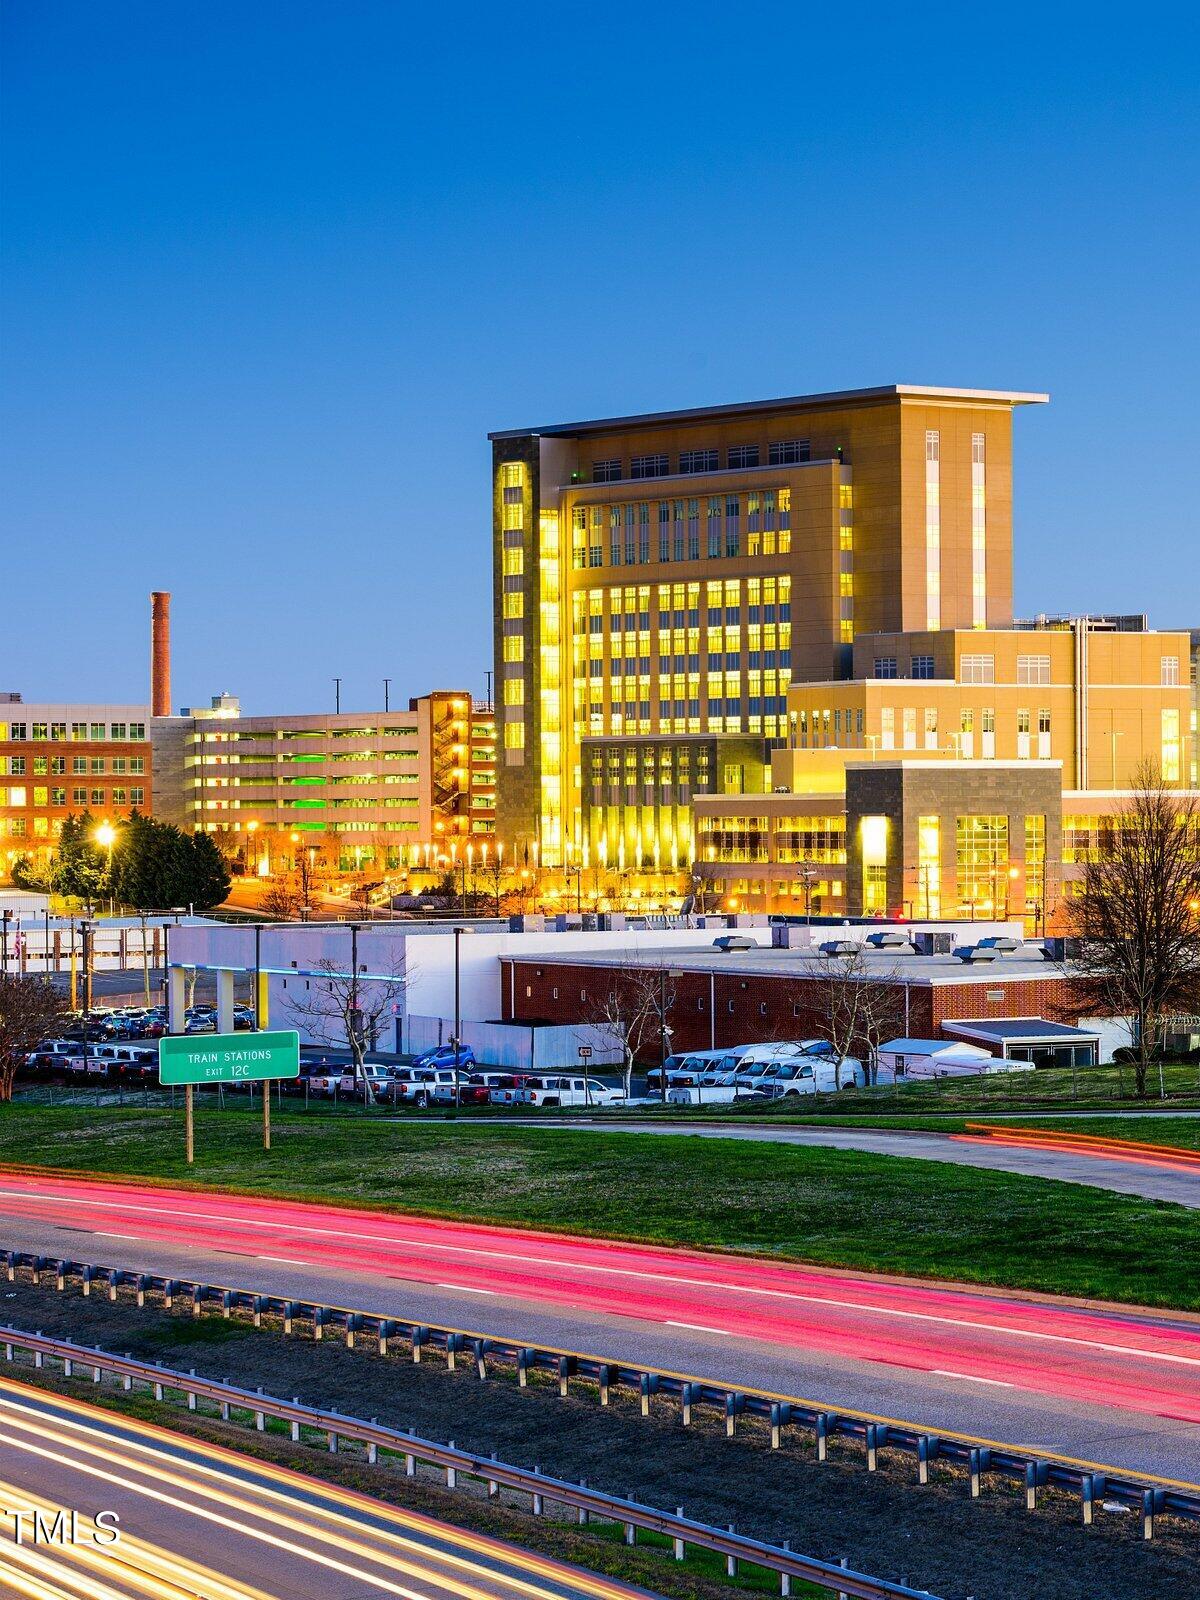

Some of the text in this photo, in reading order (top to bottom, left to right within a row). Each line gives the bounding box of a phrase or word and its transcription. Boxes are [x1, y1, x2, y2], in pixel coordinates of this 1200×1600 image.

[188, 1050, 272, 1064] TRAIN STATIONS
[206, 1065, 250, 1076] EXIT 12C
